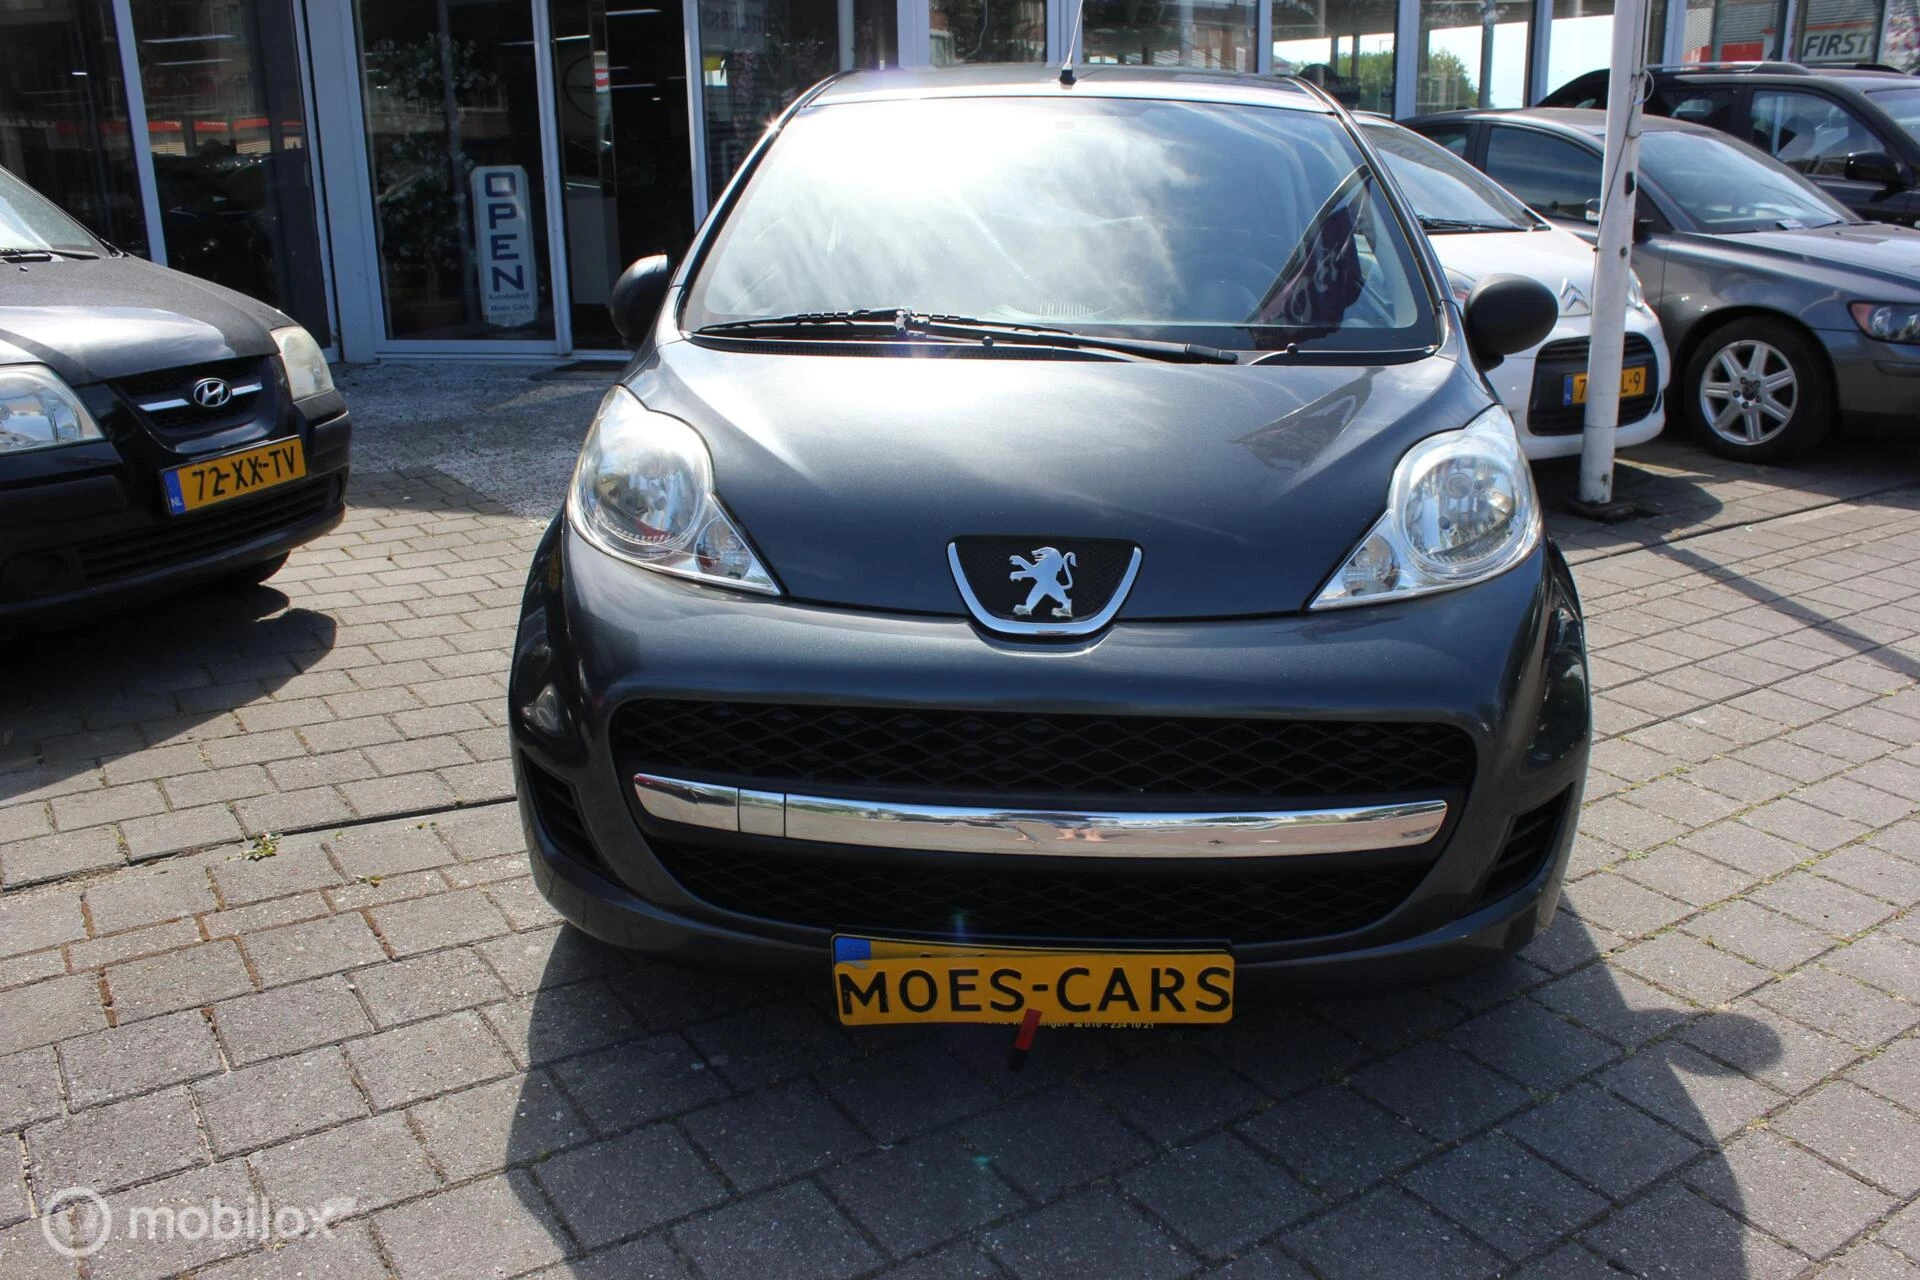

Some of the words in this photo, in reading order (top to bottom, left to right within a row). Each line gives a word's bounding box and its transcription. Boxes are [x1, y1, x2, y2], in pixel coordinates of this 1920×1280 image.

[1803, 32, 1872, 57] FIRST
[485, 172, 524, 292] OPEN
[191, 445, 295, 501] 72-XX-TV
[170, 497, 183, 508] NL
[838, 967, 1232, 1015] MOES-CARS
